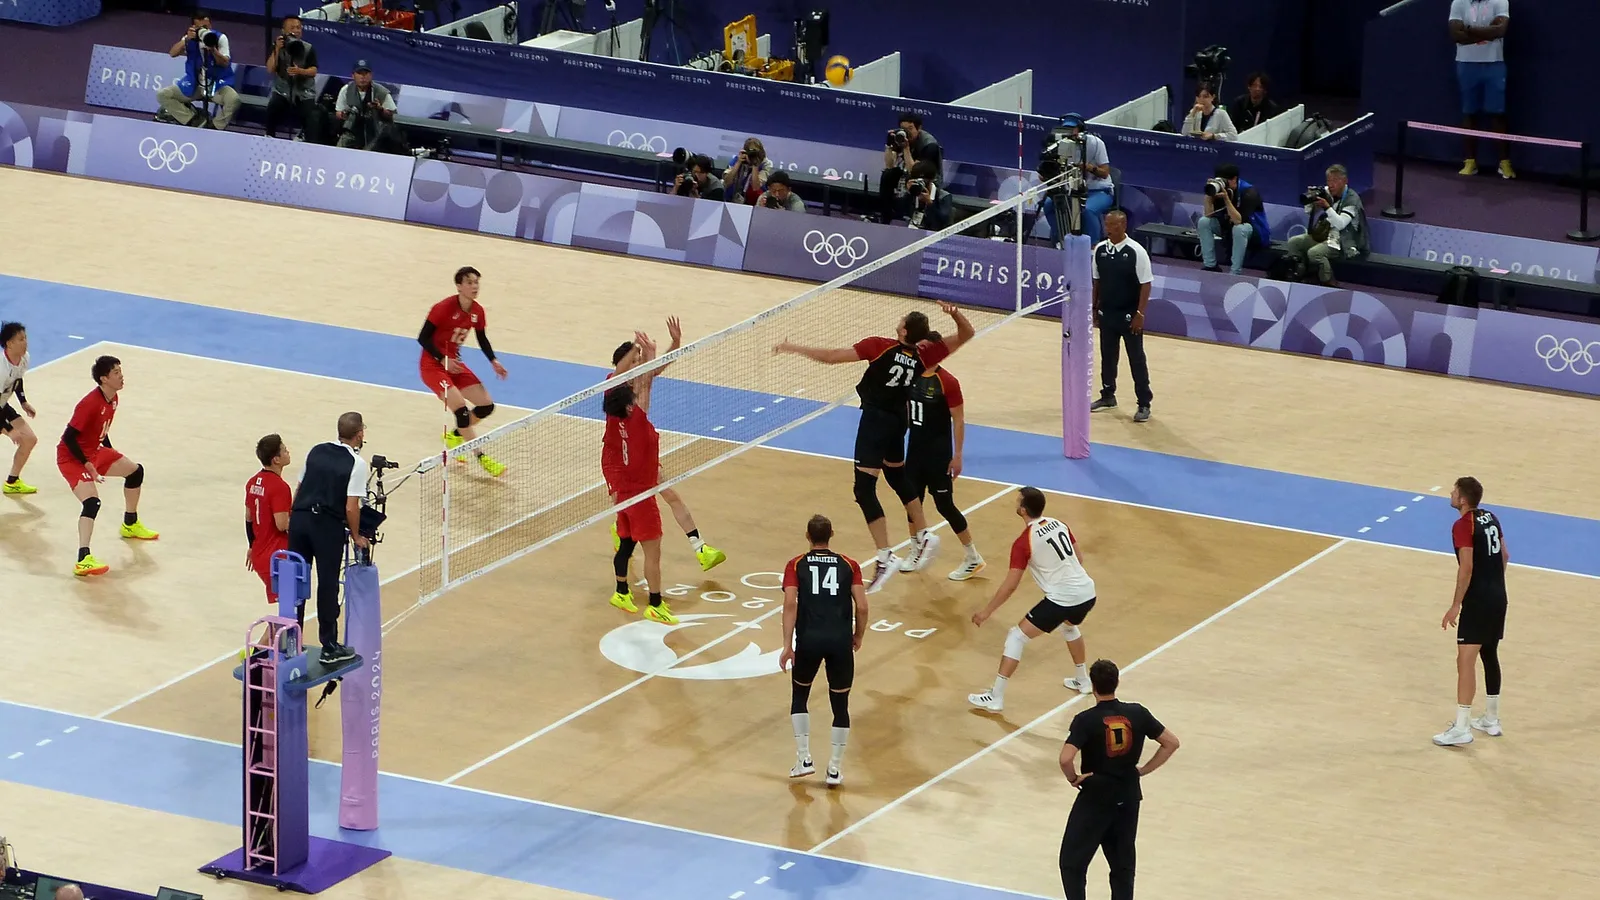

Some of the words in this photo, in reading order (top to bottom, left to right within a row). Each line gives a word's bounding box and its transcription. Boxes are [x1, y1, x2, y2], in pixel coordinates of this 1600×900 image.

[510, 52, 530, 60] PARIS
[564, 58, 583, 66] PARIS
[584, 62, 602, 70] 2024
[617, 66, 637, 74] PARIS
[638, 69, 656, 78] 2024
[672, 74, 691, 82] PARIS
[692, 77, 711, 85] 2024
[726, 82, 746, 90] PARIS
[747, 85, 766, 93] 2024
[780, 90, 800, 98] PARIS
[802, 92, 820, 101] 2024
[836, 98, 856, 106] PARIS
[858, 100, 876, 108] 2024
[914, 108, 932, 116] 2024
[948, 112, 968, 122] PARIS
[970, 116, 988, 124] 2024
[1004, 120, 1024, 129] PARS
[1026, 122, 1045, 131] 2024
[1118, 135, 1139, 144] PARIS
[1140, 138, 1160, 146] 2024
[1176, 143, 1197, 151] PARIS
[1234, 150, 1256, 159] PARIS
[1258, 153, 1278, 162] 2024
[334, 170, 395, 196] 2024
[1020, 270, 1064, 293] 202
[885, 364, 914, 388] 21
[910, 400, 924, 422] 11
[621, 440, 630, 466] 8
[254, 498, 260, 525] 1
[1046, 531, 1074, 561] 10
[1484, 525, 1500, 556] 13
[808, 566, 840, 596] 14
[372, 650, 382, 700] 2024
[1102, 715, 1133, 758] D
